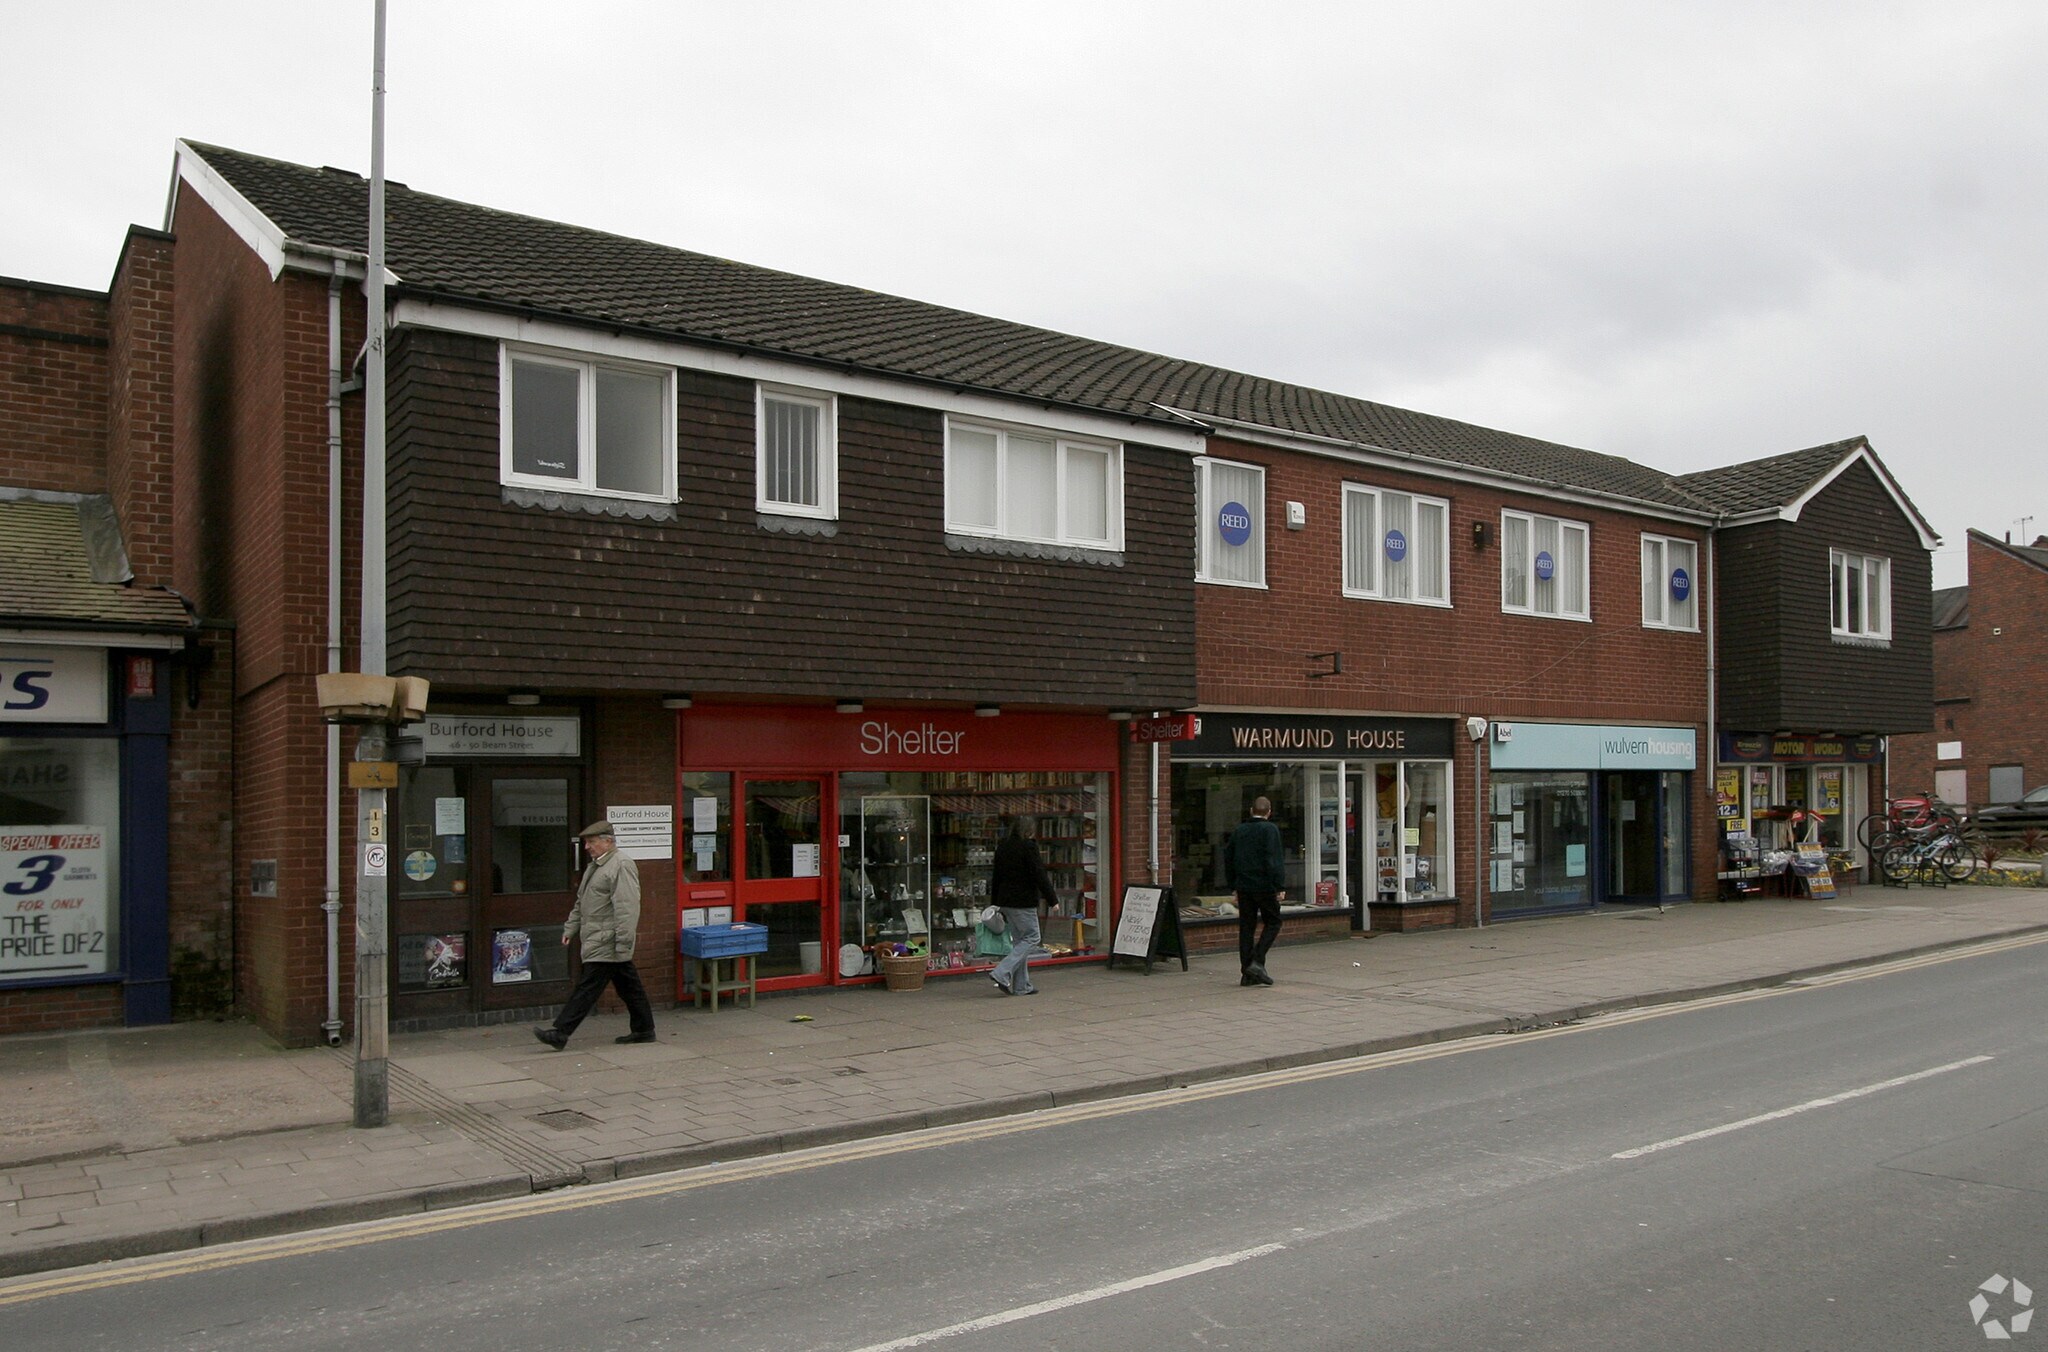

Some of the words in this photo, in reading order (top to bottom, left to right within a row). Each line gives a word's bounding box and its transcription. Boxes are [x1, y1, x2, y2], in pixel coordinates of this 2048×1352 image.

[1222, 514, 1248, 529] REED
[1386, 538, 1404, 549] REED
[1536, 560, 1552, 570] REED
[1672, 577, 1689, 588] REED
[0, 670, 53, 710] S
[430, 722, 496, 738] Burford
[502, 724, 553, 738] House
[861, 721, 965, 754] Shelter
[1141, 722, 1184, 739] Shelter
[482, 741, 506, 749] Beam
[508, 741, 534, 749] Street
[1232, 727, 1334, 748] WARMUND
[1347, 729, 1405, 749] HOUSE
[1773, 741, 1804, 754] MOTOR
[1813, 743, 1843, 755] WORLD
[1818, 772, 1839, 780] FREE
[610, 811, 642, 819] Burford
[1730, 820, 1743, 830] FREE
[1, 835, 56, 850] SPECIAL
[59, 834, 100, 849] OFFER
[3, 855, 66, 895] 3
[17, 901, 44, 911] FOR
[51, 899, 84, 909] ONLY
[3, 915, 49, 935] THE
[1, 935, 55, 957] PRICE
